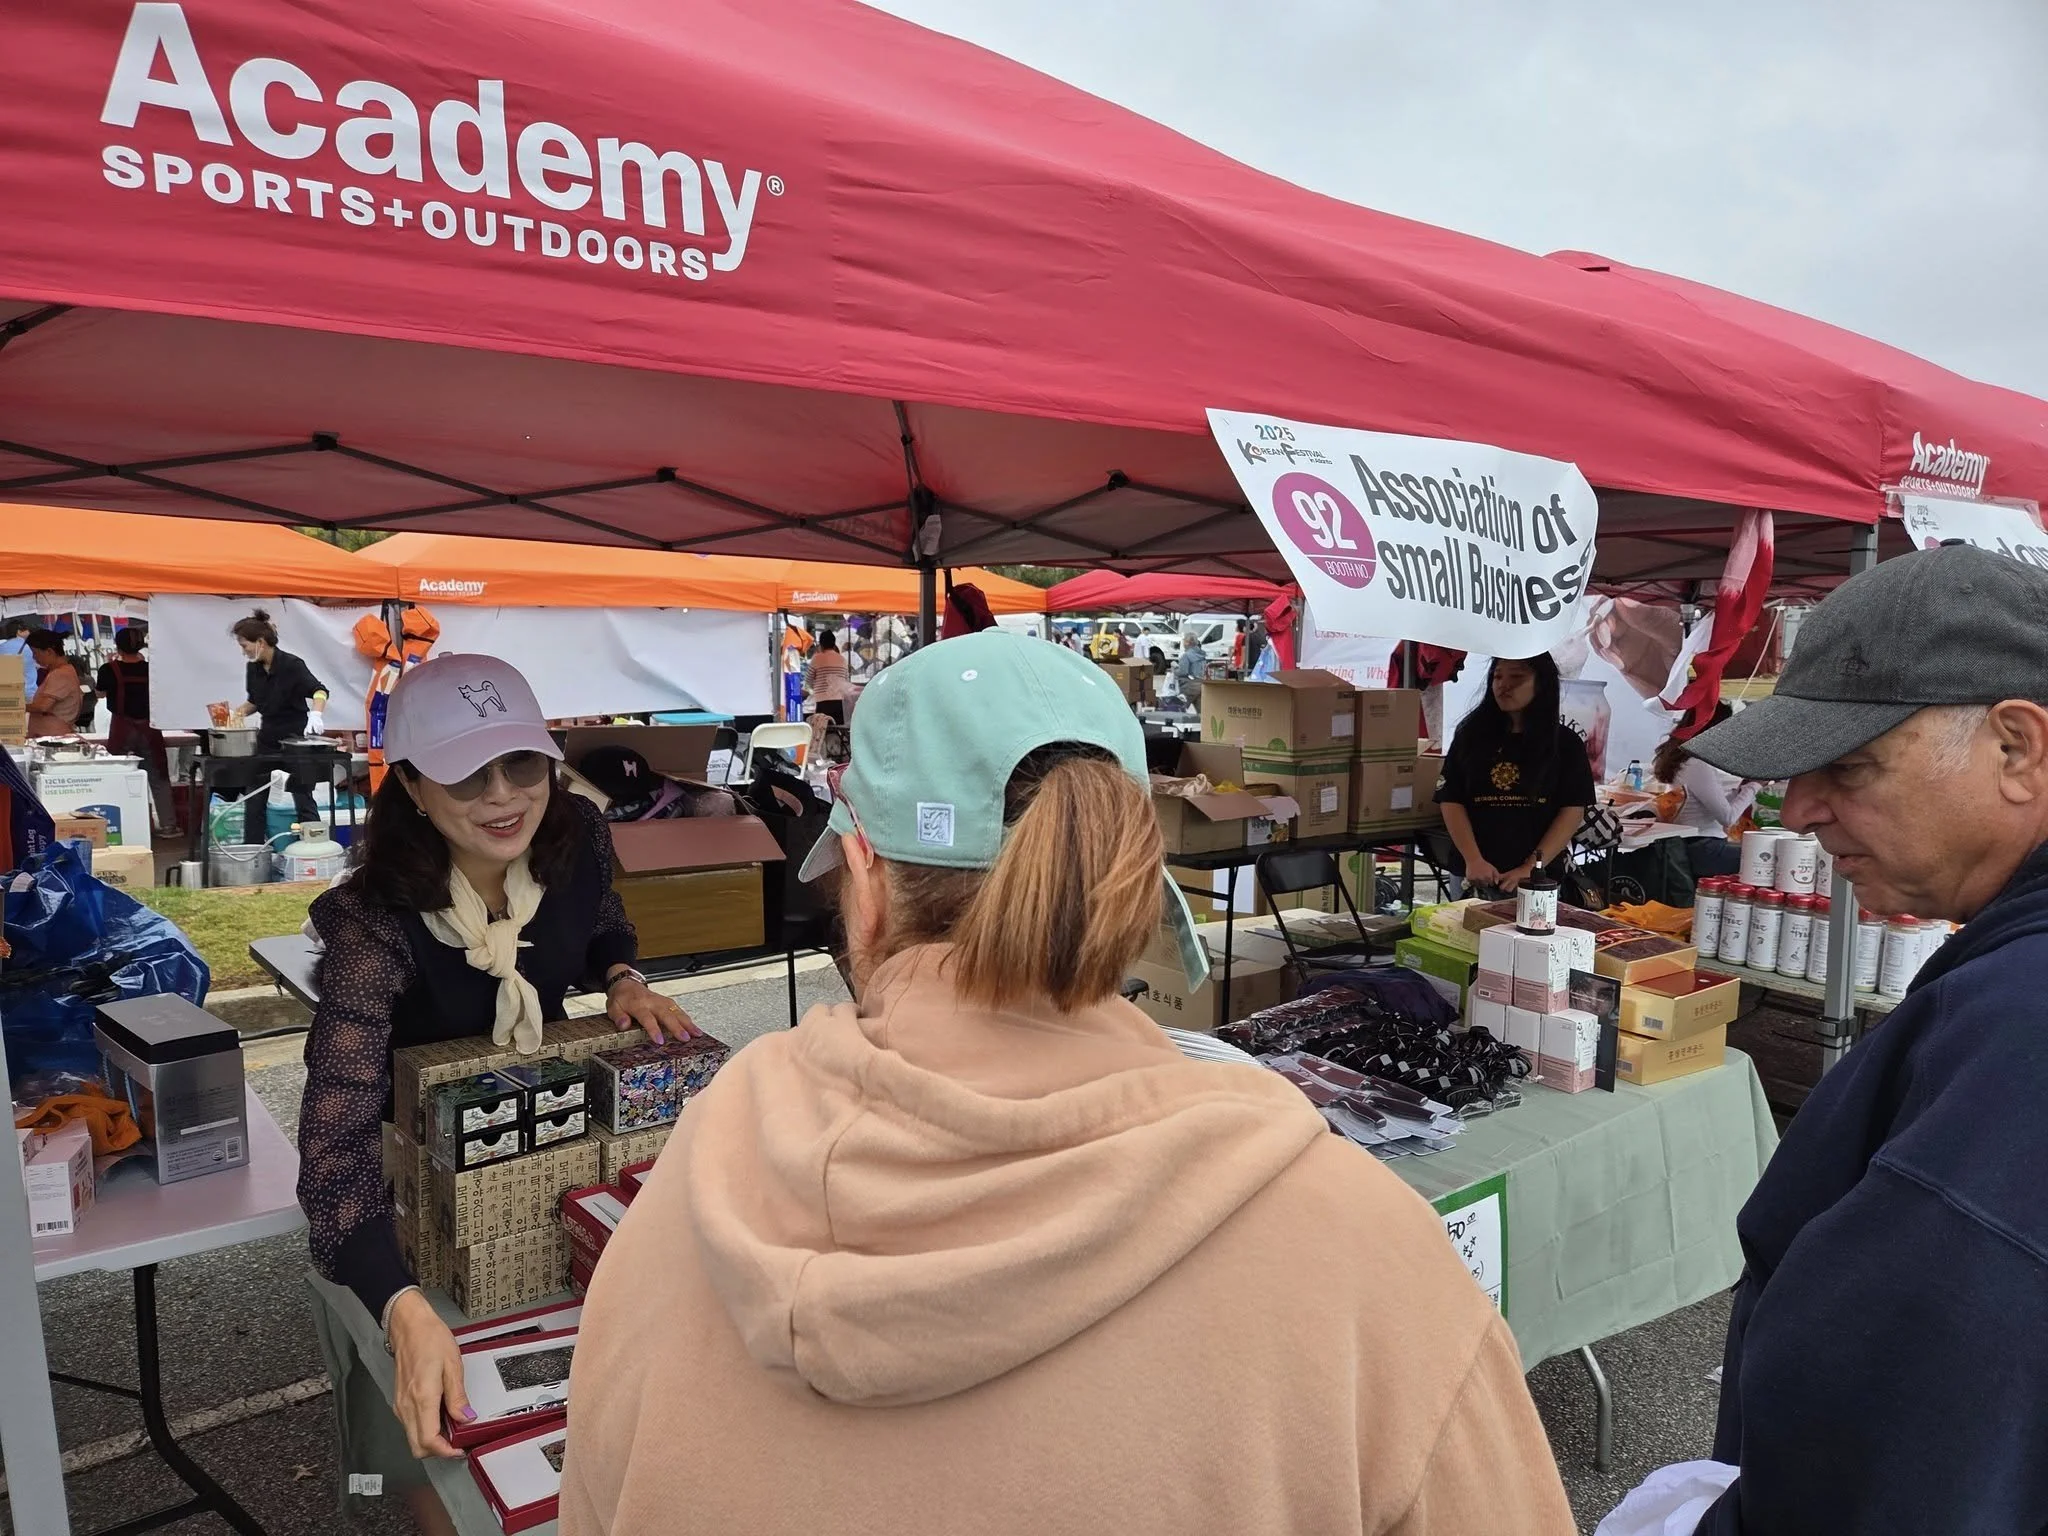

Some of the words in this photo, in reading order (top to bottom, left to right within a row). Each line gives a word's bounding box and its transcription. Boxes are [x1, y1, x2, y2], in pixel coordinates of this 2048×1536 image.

[102, 145, 709, 282] SPORTS+OUTDOORS
[1254, 424, 1296, 442] 2025
[1909, 431, 1988, 496] Academy
[1291, 490, 1358, 550] 92
[1348, 454, 1525, 552] Association
[1532, 493, 1578, 554] of
[419, 578, 484, 595] Academy
[792, 590, 839, 603] Academy
[1325, 560, 1357, 577] BOOTH
[1376, 536, 1465, 611] small
